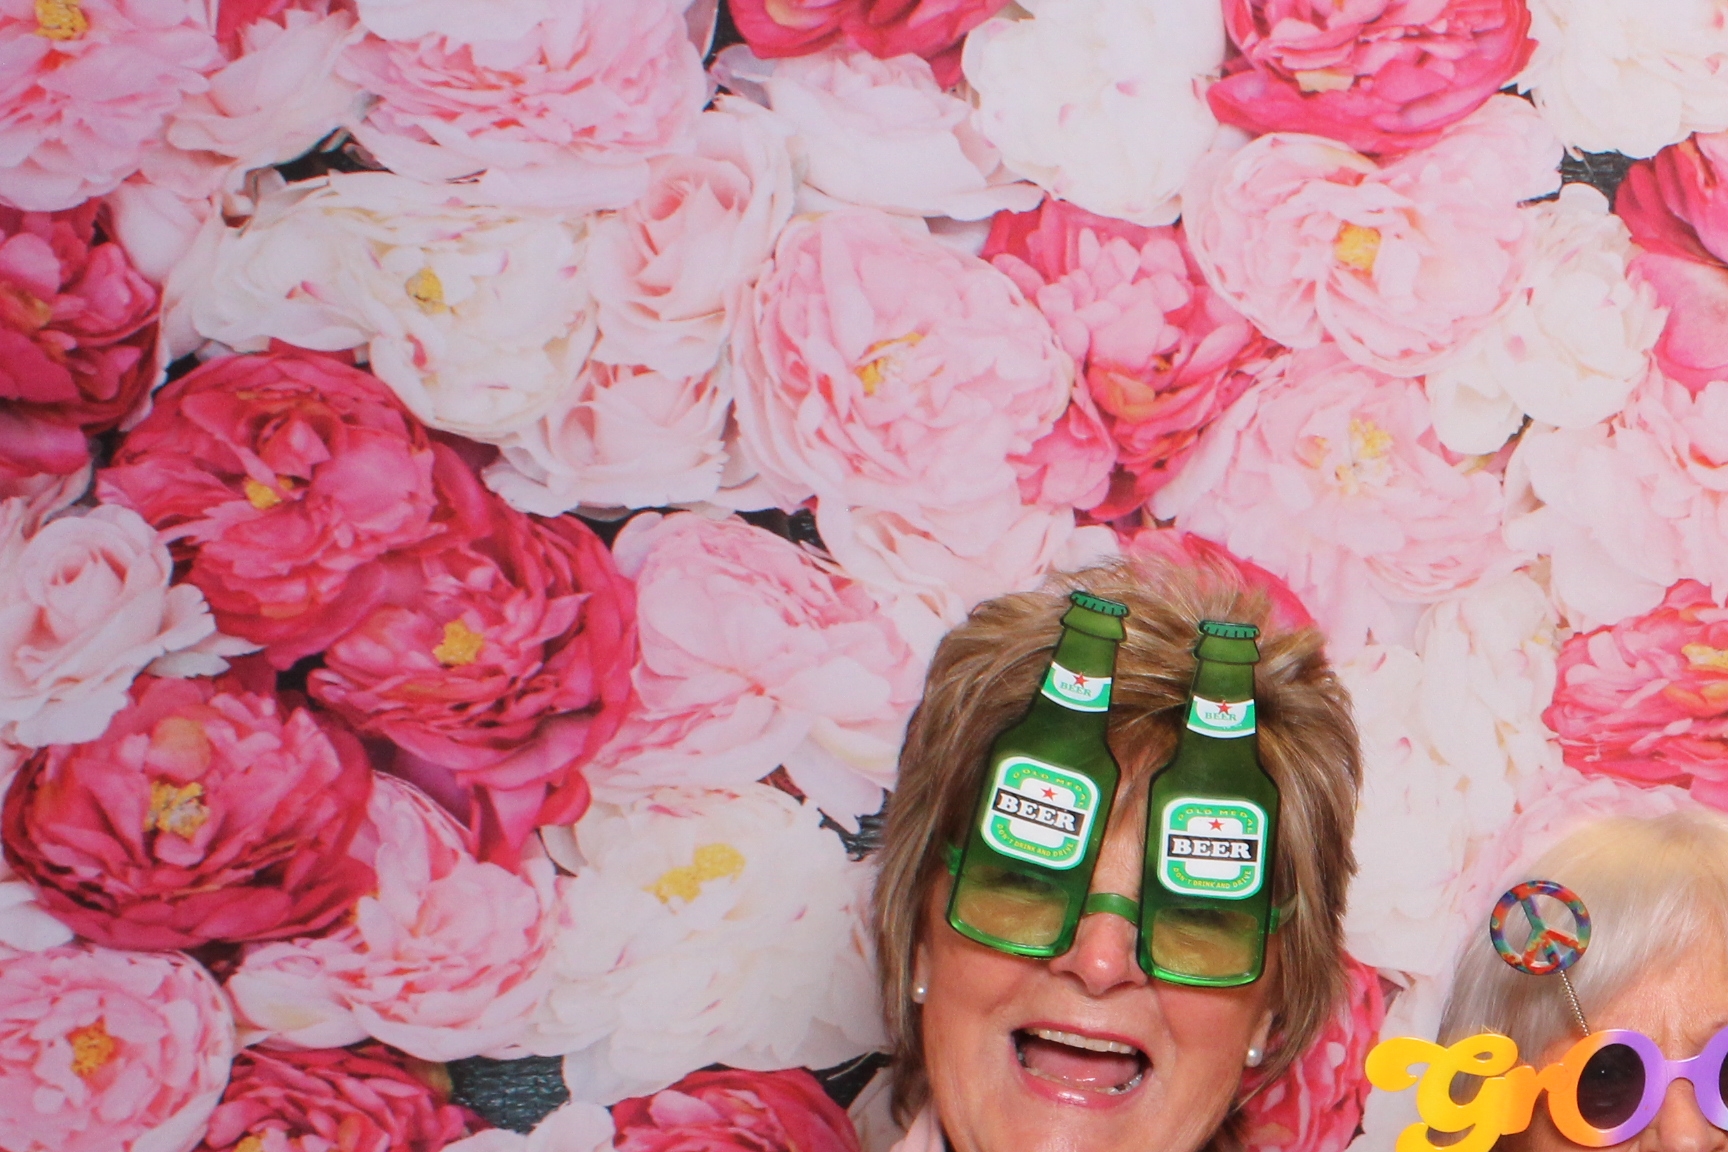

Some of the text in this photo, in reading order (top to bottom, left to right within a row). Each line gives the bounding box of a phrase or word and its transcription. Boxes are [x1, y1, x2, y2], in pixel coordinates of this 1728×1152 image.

[1060, 681, 1092, 697] BEER
[1204, 711, 1237, 722] BEER
[1013, 768, 1086, 807] GOLD MEDAL
[997, 793, 1076, 832] BEER
[1178, 808, 1254, 833] GOLD MEDAL
[996, 823, 1074, 858] DON'T DRINK AND DRIVE
[1172, 837, 1252, 860] BEER
[1173, 866, 1192, 885] DON'T
[1193, 880, 1215, 888] DRINK
[1232, 869, 1252, 888] DRIVE
